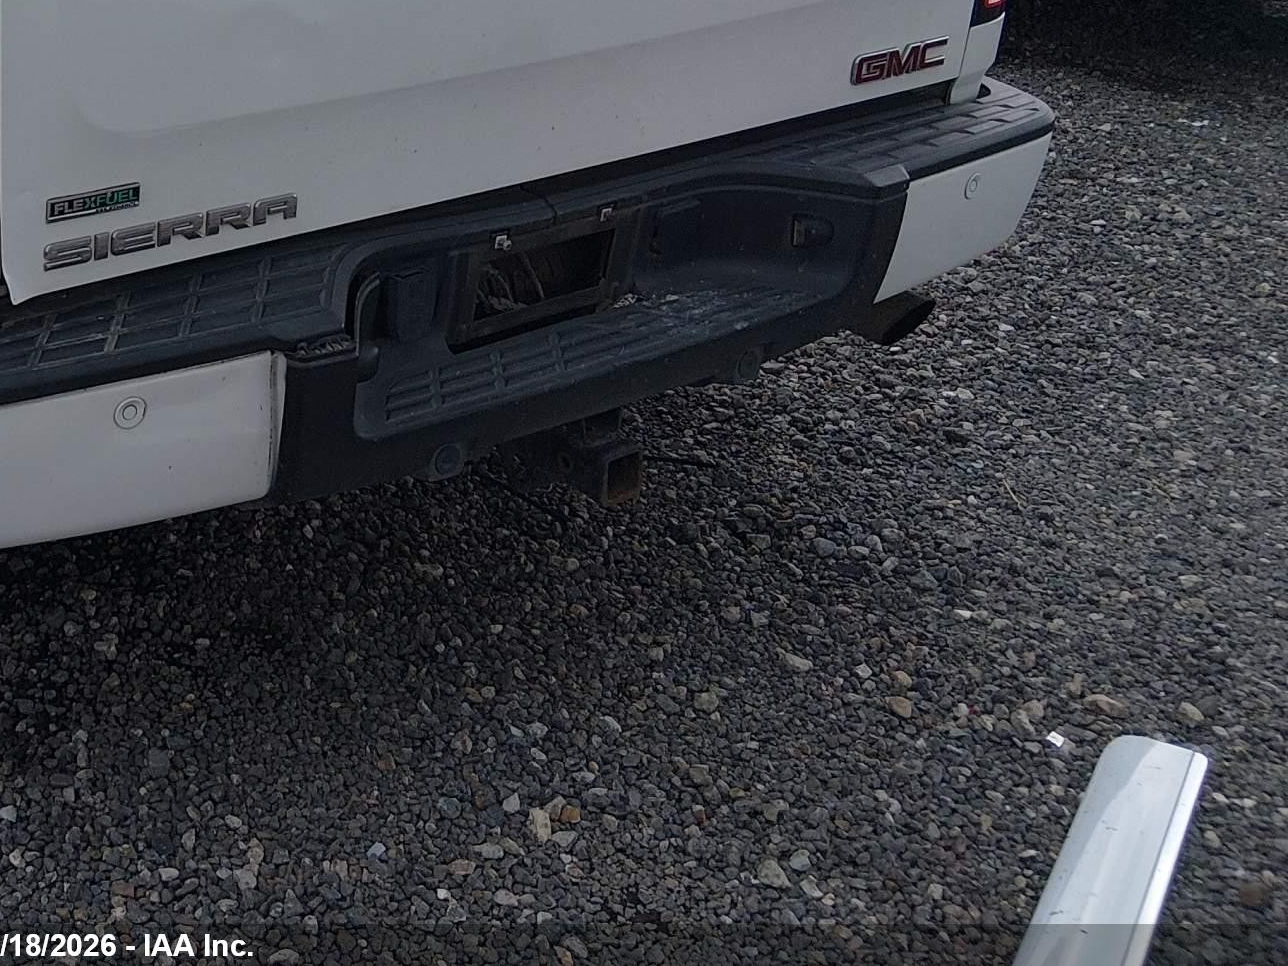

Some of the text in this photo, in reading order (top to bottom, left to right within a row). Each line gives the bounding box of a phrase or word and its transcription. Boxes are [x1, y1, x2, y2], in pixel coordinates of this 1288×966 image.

[850, 35, 950, 86] GMC
[54, 188, 138, 215] FLEXFUEL
[43, 192, 298, 272] SIERRA
